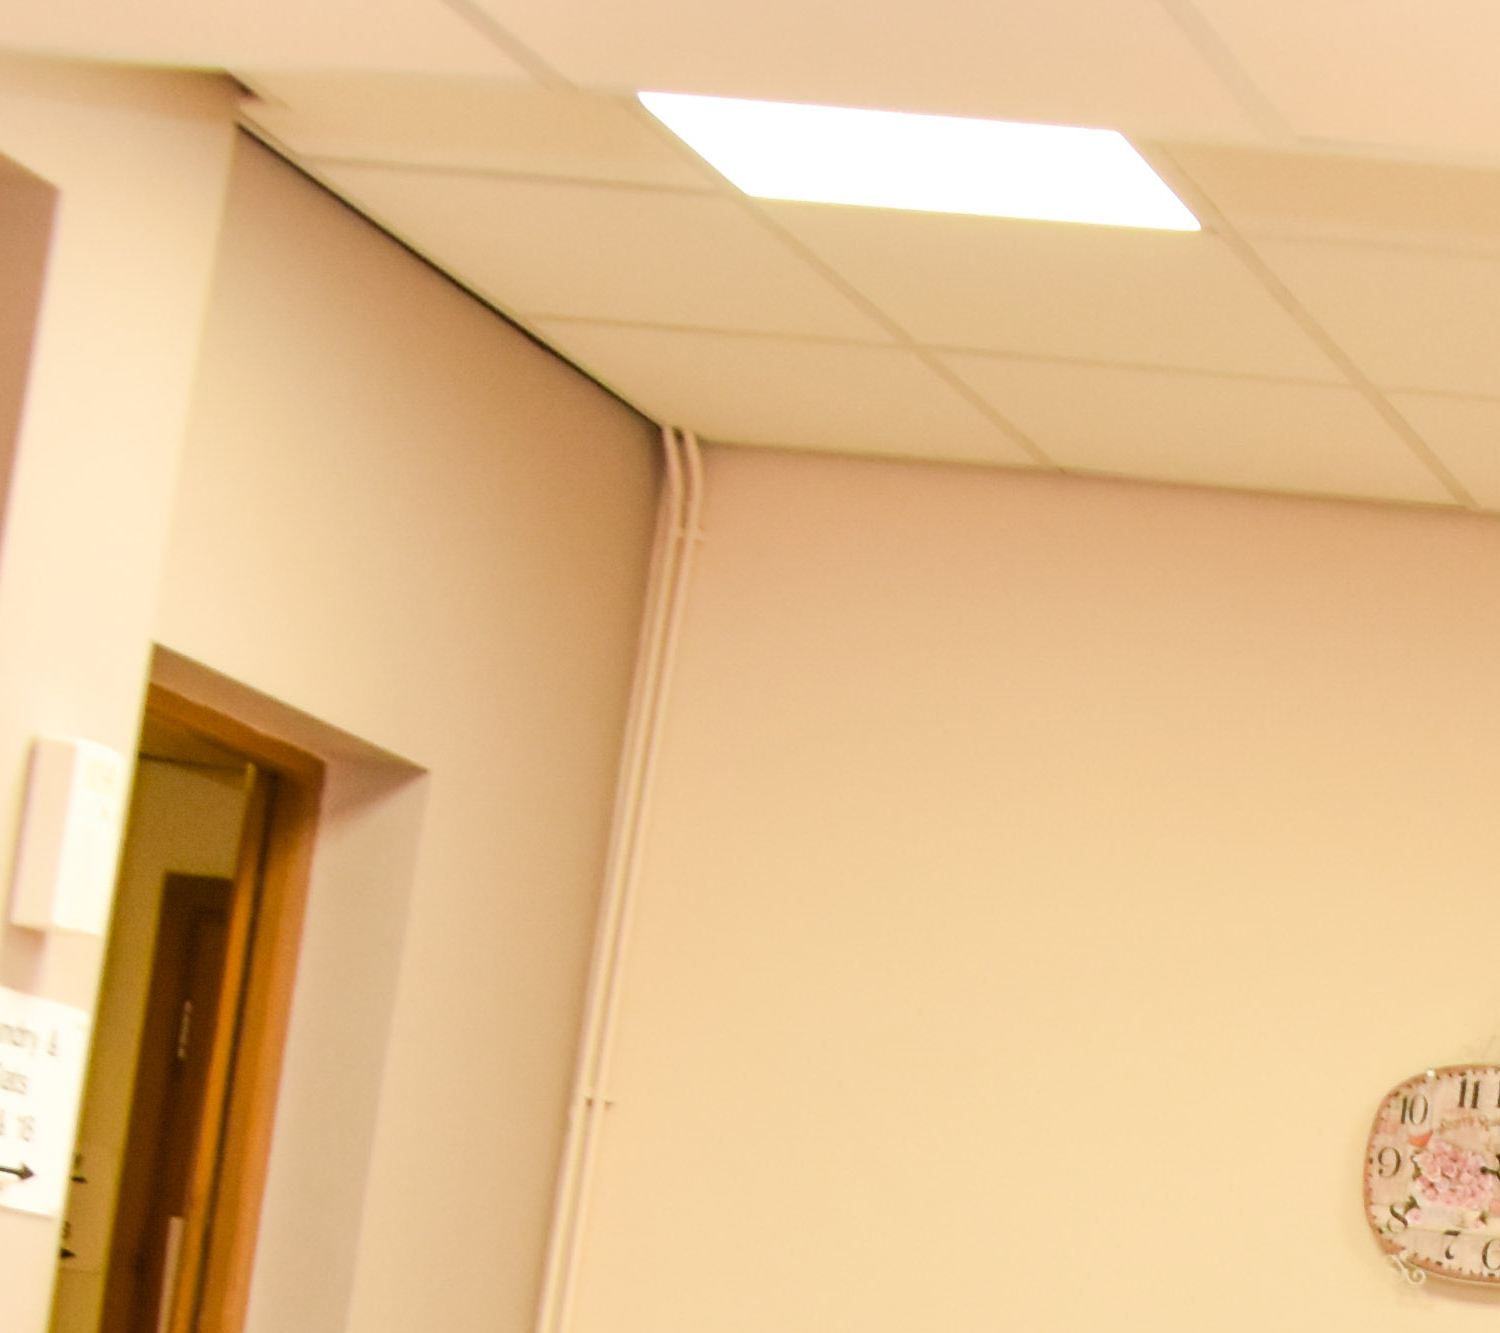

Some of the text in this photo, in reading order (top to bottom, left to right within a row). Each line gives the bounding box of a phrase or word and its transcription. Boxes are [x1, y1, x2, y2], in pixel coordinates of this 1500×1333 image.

[1457, 1077, 1480, 1109] 11
[1400, 1094, 1429, 1126] 10
[1377, 1147, 1402, 1178] 9
[1443, 1230, 1461, 1260] 7
